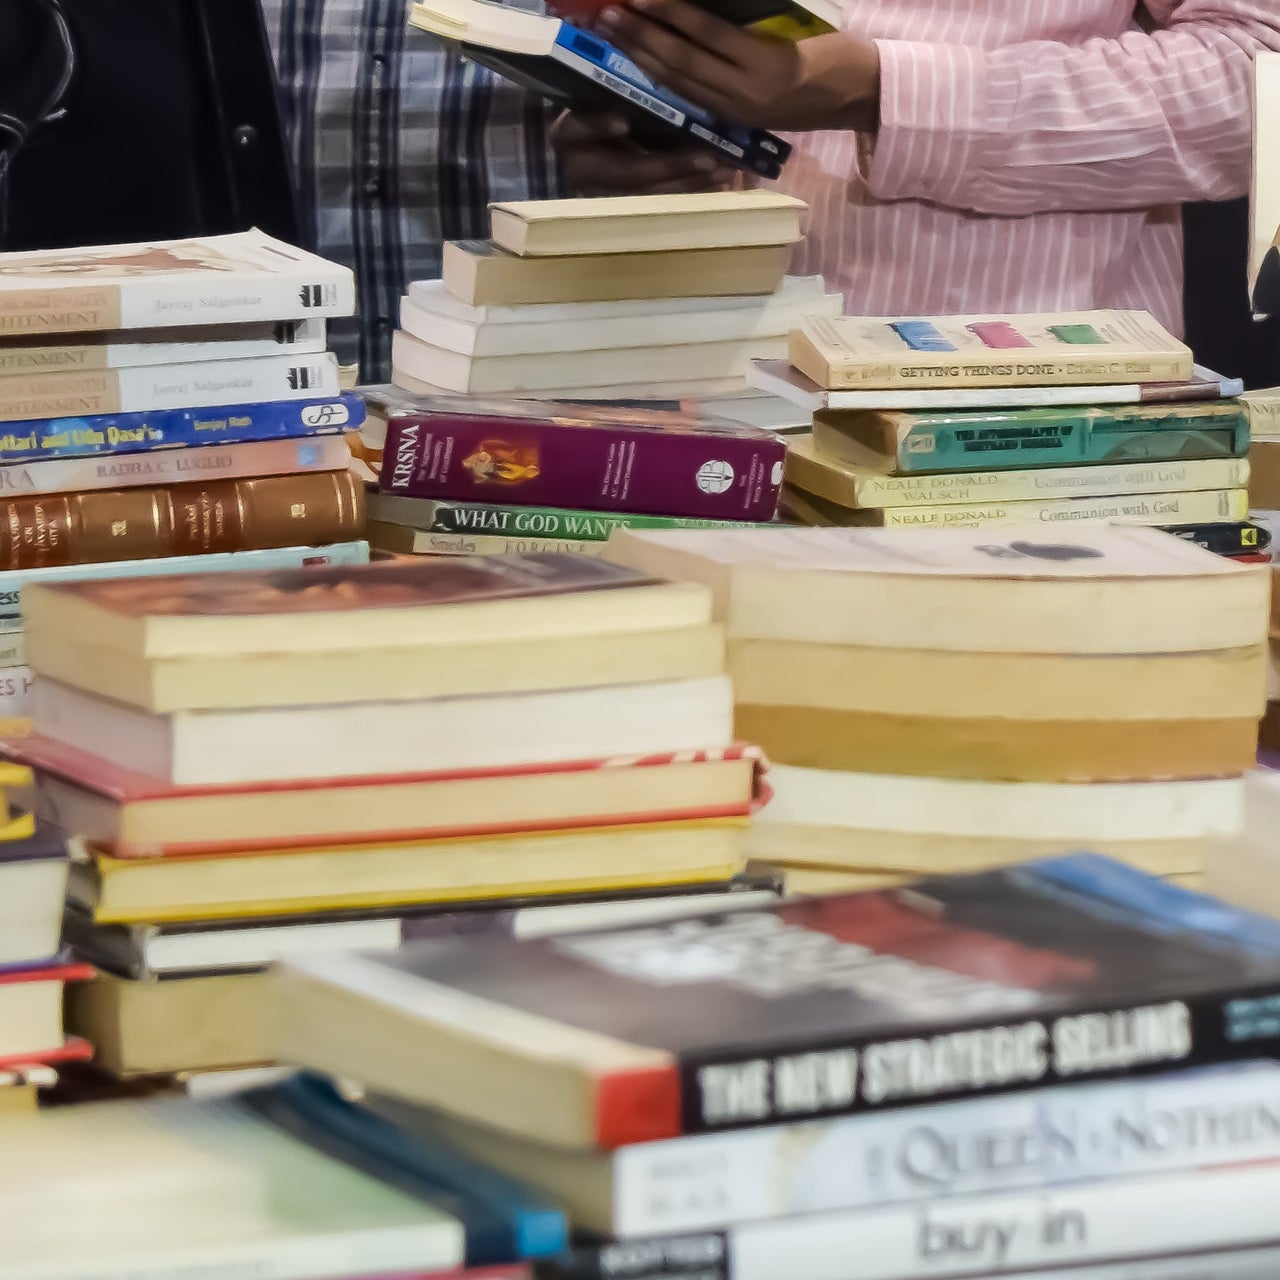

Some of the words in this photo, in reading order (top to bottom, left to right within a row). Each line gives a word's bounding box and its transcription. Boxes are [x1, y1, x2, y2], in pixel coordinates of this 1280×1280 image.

[900, 366, 960, 379] GETTING
[962, 365, 1013, 377] THINGS
[1015, 364, 1054, 376] DONE
[873, 478, 925, 491] NEALE
[929, 475, 999, 489] DONALD
[902, 488, 970, 501] WALSCH
[453, 508, 511, 530] WHAT
[514, 512, 560, 533] GOD
[891, 512, 940, 526] NEALE
[943, 508, 1007, 523] DONALD
[1039, 505, 1119, 524] Communion
[1121, 502, 1150, 518] with
[1152, 499, 1180, 515] God
[699, 1058, 768, 1122] THE
[775, 1047, 858, 1112] NEW
[862, 1023, 1047, 1102] STRATEGIC
[1053, 1001, 1192, 1073] SELLING
[893, 1121, 1078, 1187] QUEEN
[918, 1206, 1018, 1261] buy
[1039, 1197, 1088, 1245] in
